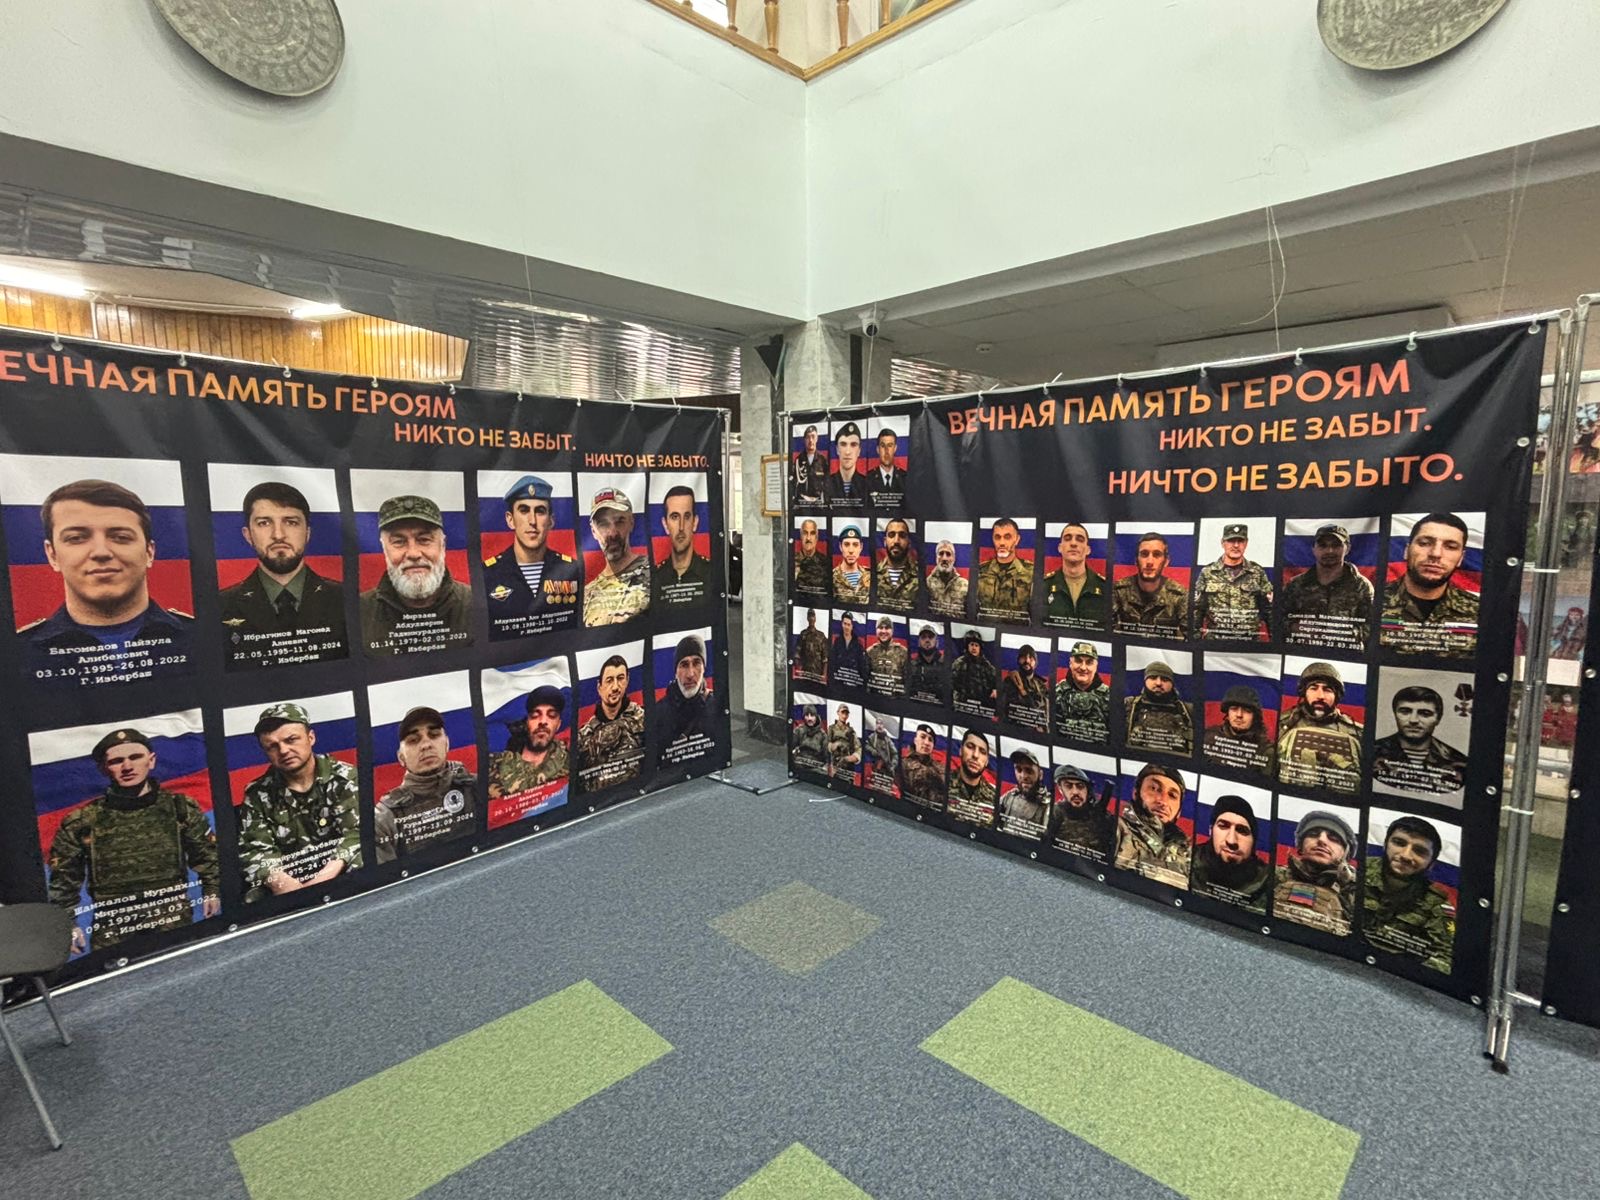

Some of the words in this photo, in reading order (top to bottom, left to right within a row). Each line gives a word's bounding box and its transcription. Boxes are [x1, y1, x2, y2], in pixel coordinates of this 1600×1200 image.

[167, 368, 327, 409] ПАМЯТЬ
[335, 387, 456, 420] ГЕРОЯМ
[948, 399, 1056, 435] ВЕЧНАЯ
[1063, 385, 1211, 425] ПАМЯТЬ
[1221, 359, 1410, 412] ГЕРОЯМ
[394, 423, 474, 446] НИКТО
[479, 428, 505, 448] НЕ
[509, 430, 576, 451] ЗАБЫТ.
[1159, 424, 1254, 451] НИКТО
[1259, 419, 1297, 443] НЕ
[1304, 408, 1432, 441] ЗАБЫТ.
[585, 453, 633, 467] НИЧТО
[637, 454, 655, 467] НЕ
[658, 455, 709, 468] ЗАБЫТО.
[1108, 467, 1218, 494] НИЧТО
[1225, 464, 1269, 492] НЕ
[1276, 453, 1463, 490] ЗАБЫТО.
[243, 631, 292, 641] Ибрагимов
[296, 627, 331, 635] Магомед
[271, 638, 308, 647] Алиевич
[49, 643, 118, 655] Багомедов
[78, 650, 149, 664] Алибекович
[278, 654, 319, 664] Избербаш
[143, 879, 202, 898] Мурадхан
